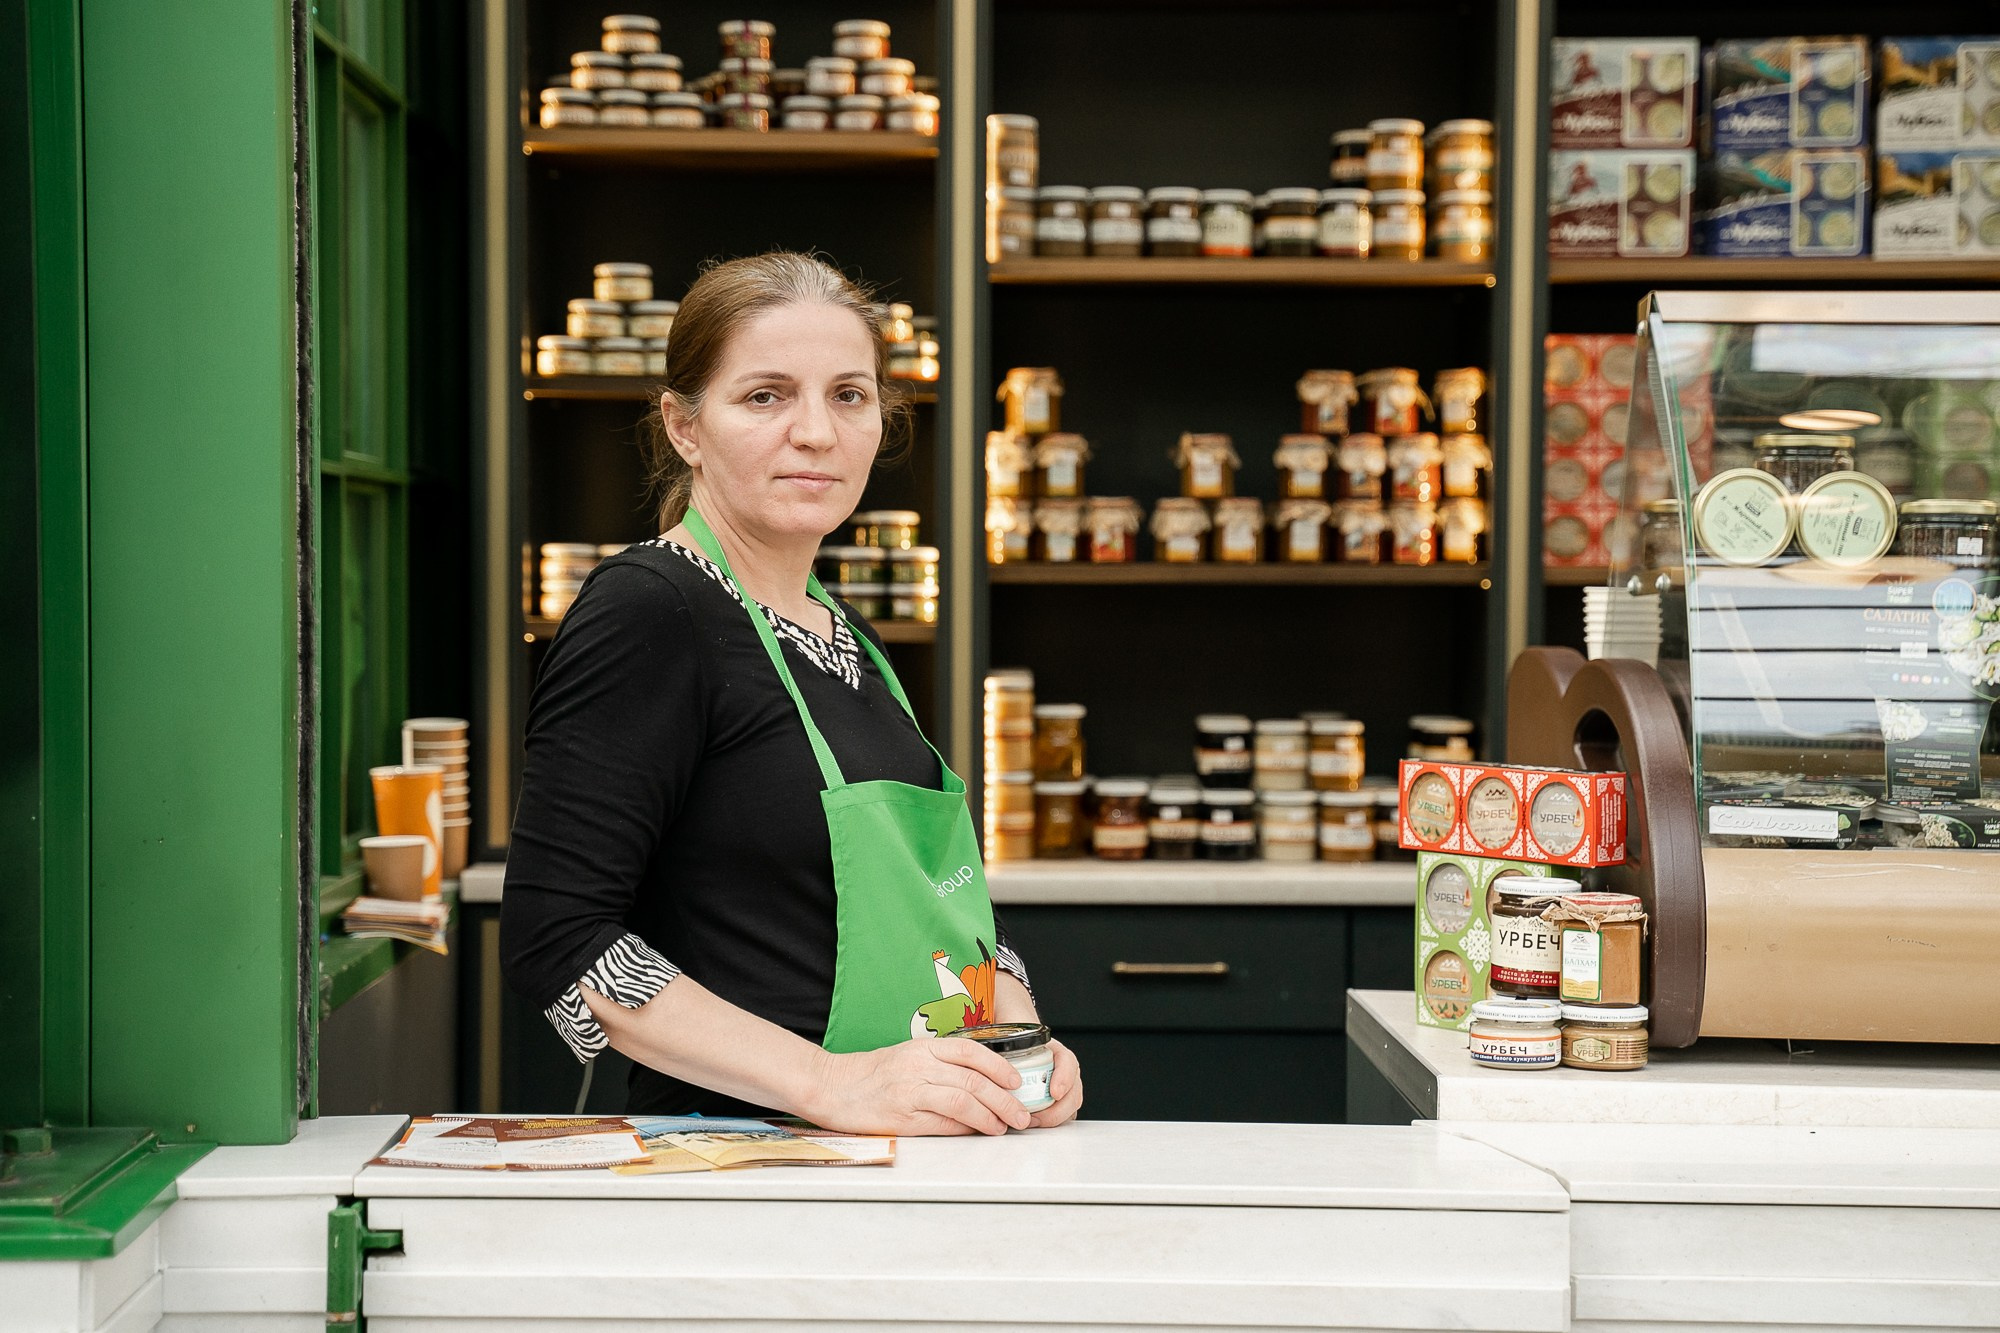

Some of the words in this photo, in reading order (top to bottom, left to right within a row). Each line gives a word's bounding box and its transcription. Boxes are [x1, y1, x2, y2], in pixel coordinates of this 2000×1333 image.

[1863, 608, 1930, 624] САЛАТИК
[1476, 809, 1511, 819] УРБЕЧ
[1540, 813, 1576, 824] УРБЕЧ
[1433, 892, 1465, 904] УРБЕЧ
[1499, 929, 1560, 950] УРБЕЧ
[1431, 978, 1462, 990] УРБЕЧ
[1481, 1043, 1527, 1055] УРБЕЧ
[1576, 1048, 1605, 1059] УРБЕЧ
